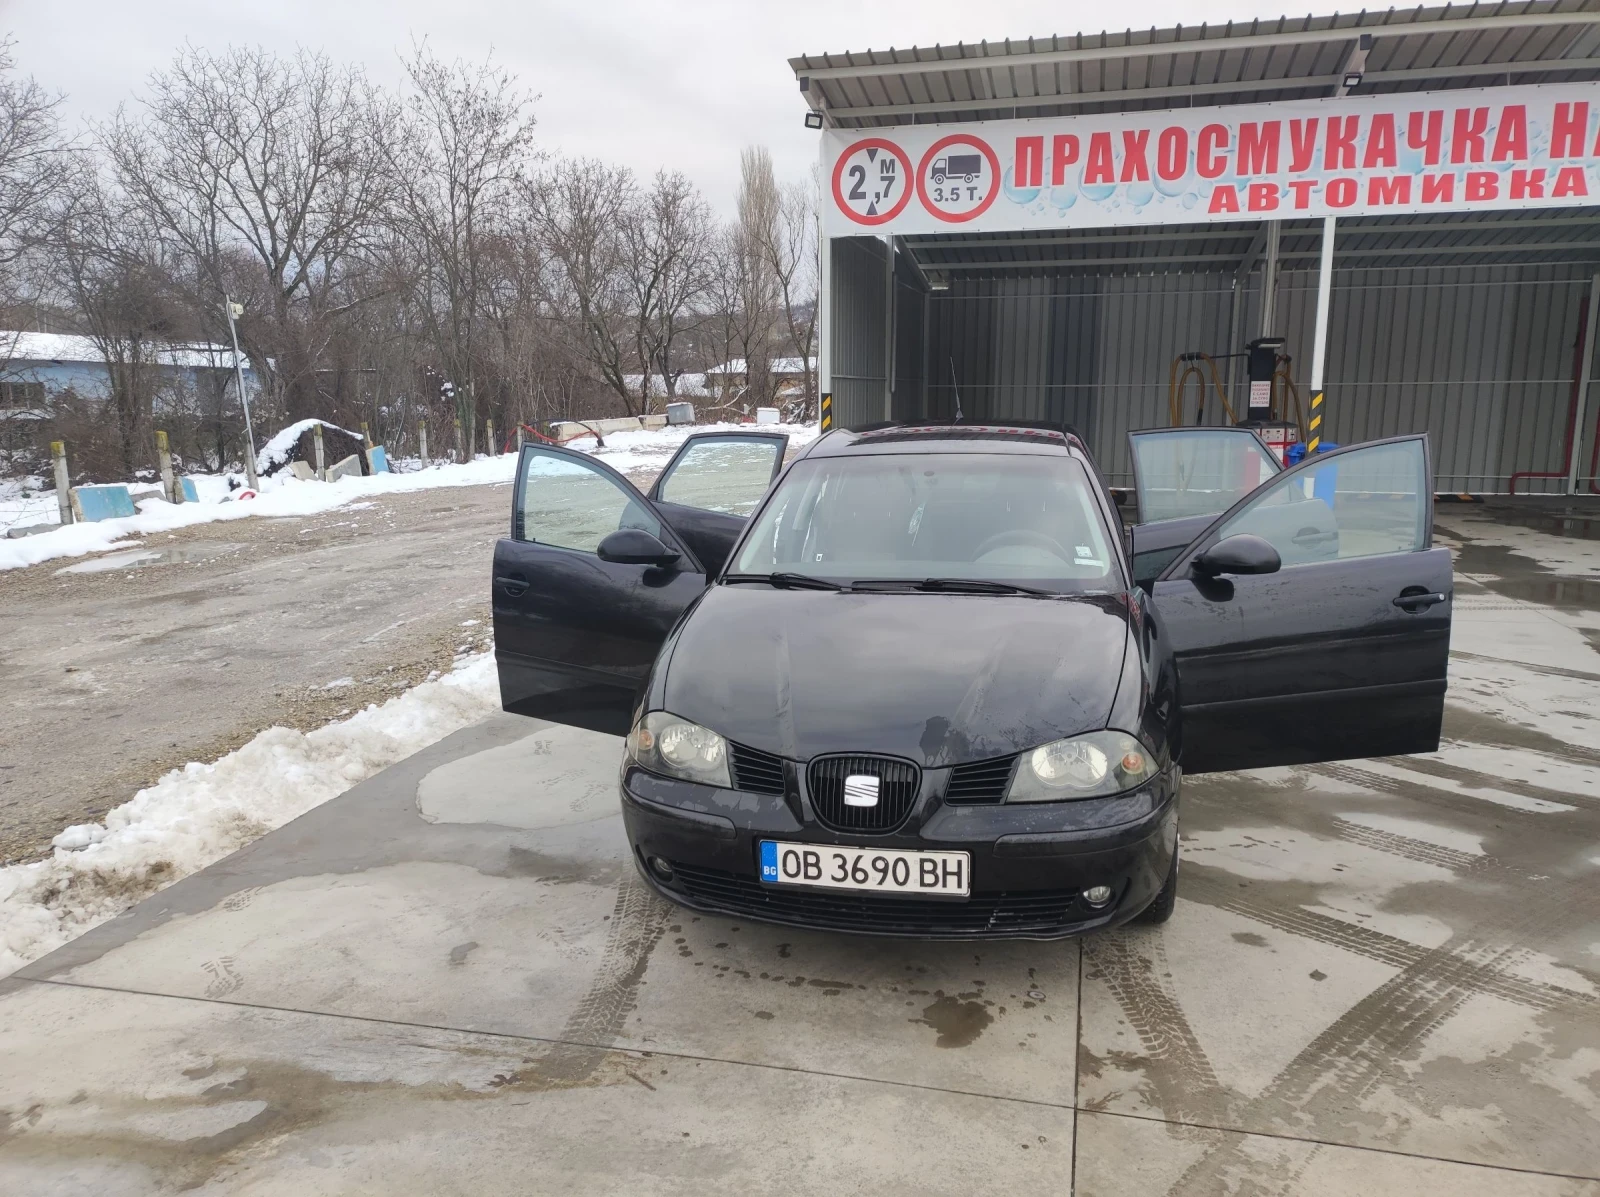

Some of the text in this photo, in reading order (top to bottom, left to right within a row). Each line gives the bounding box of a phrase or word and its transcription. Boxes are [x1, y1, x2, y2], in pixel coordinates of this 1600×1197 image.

[1014, 101, 1600, 188] ПРАХОСМУКАЧКА Н
[933, 187, 960, 202] 3.5
[1208, 167, 1589, 214] АВТОМИВКА
[763, 865, 777, 876] BG
[781, 850, 963, 889] OB 3690 BH
